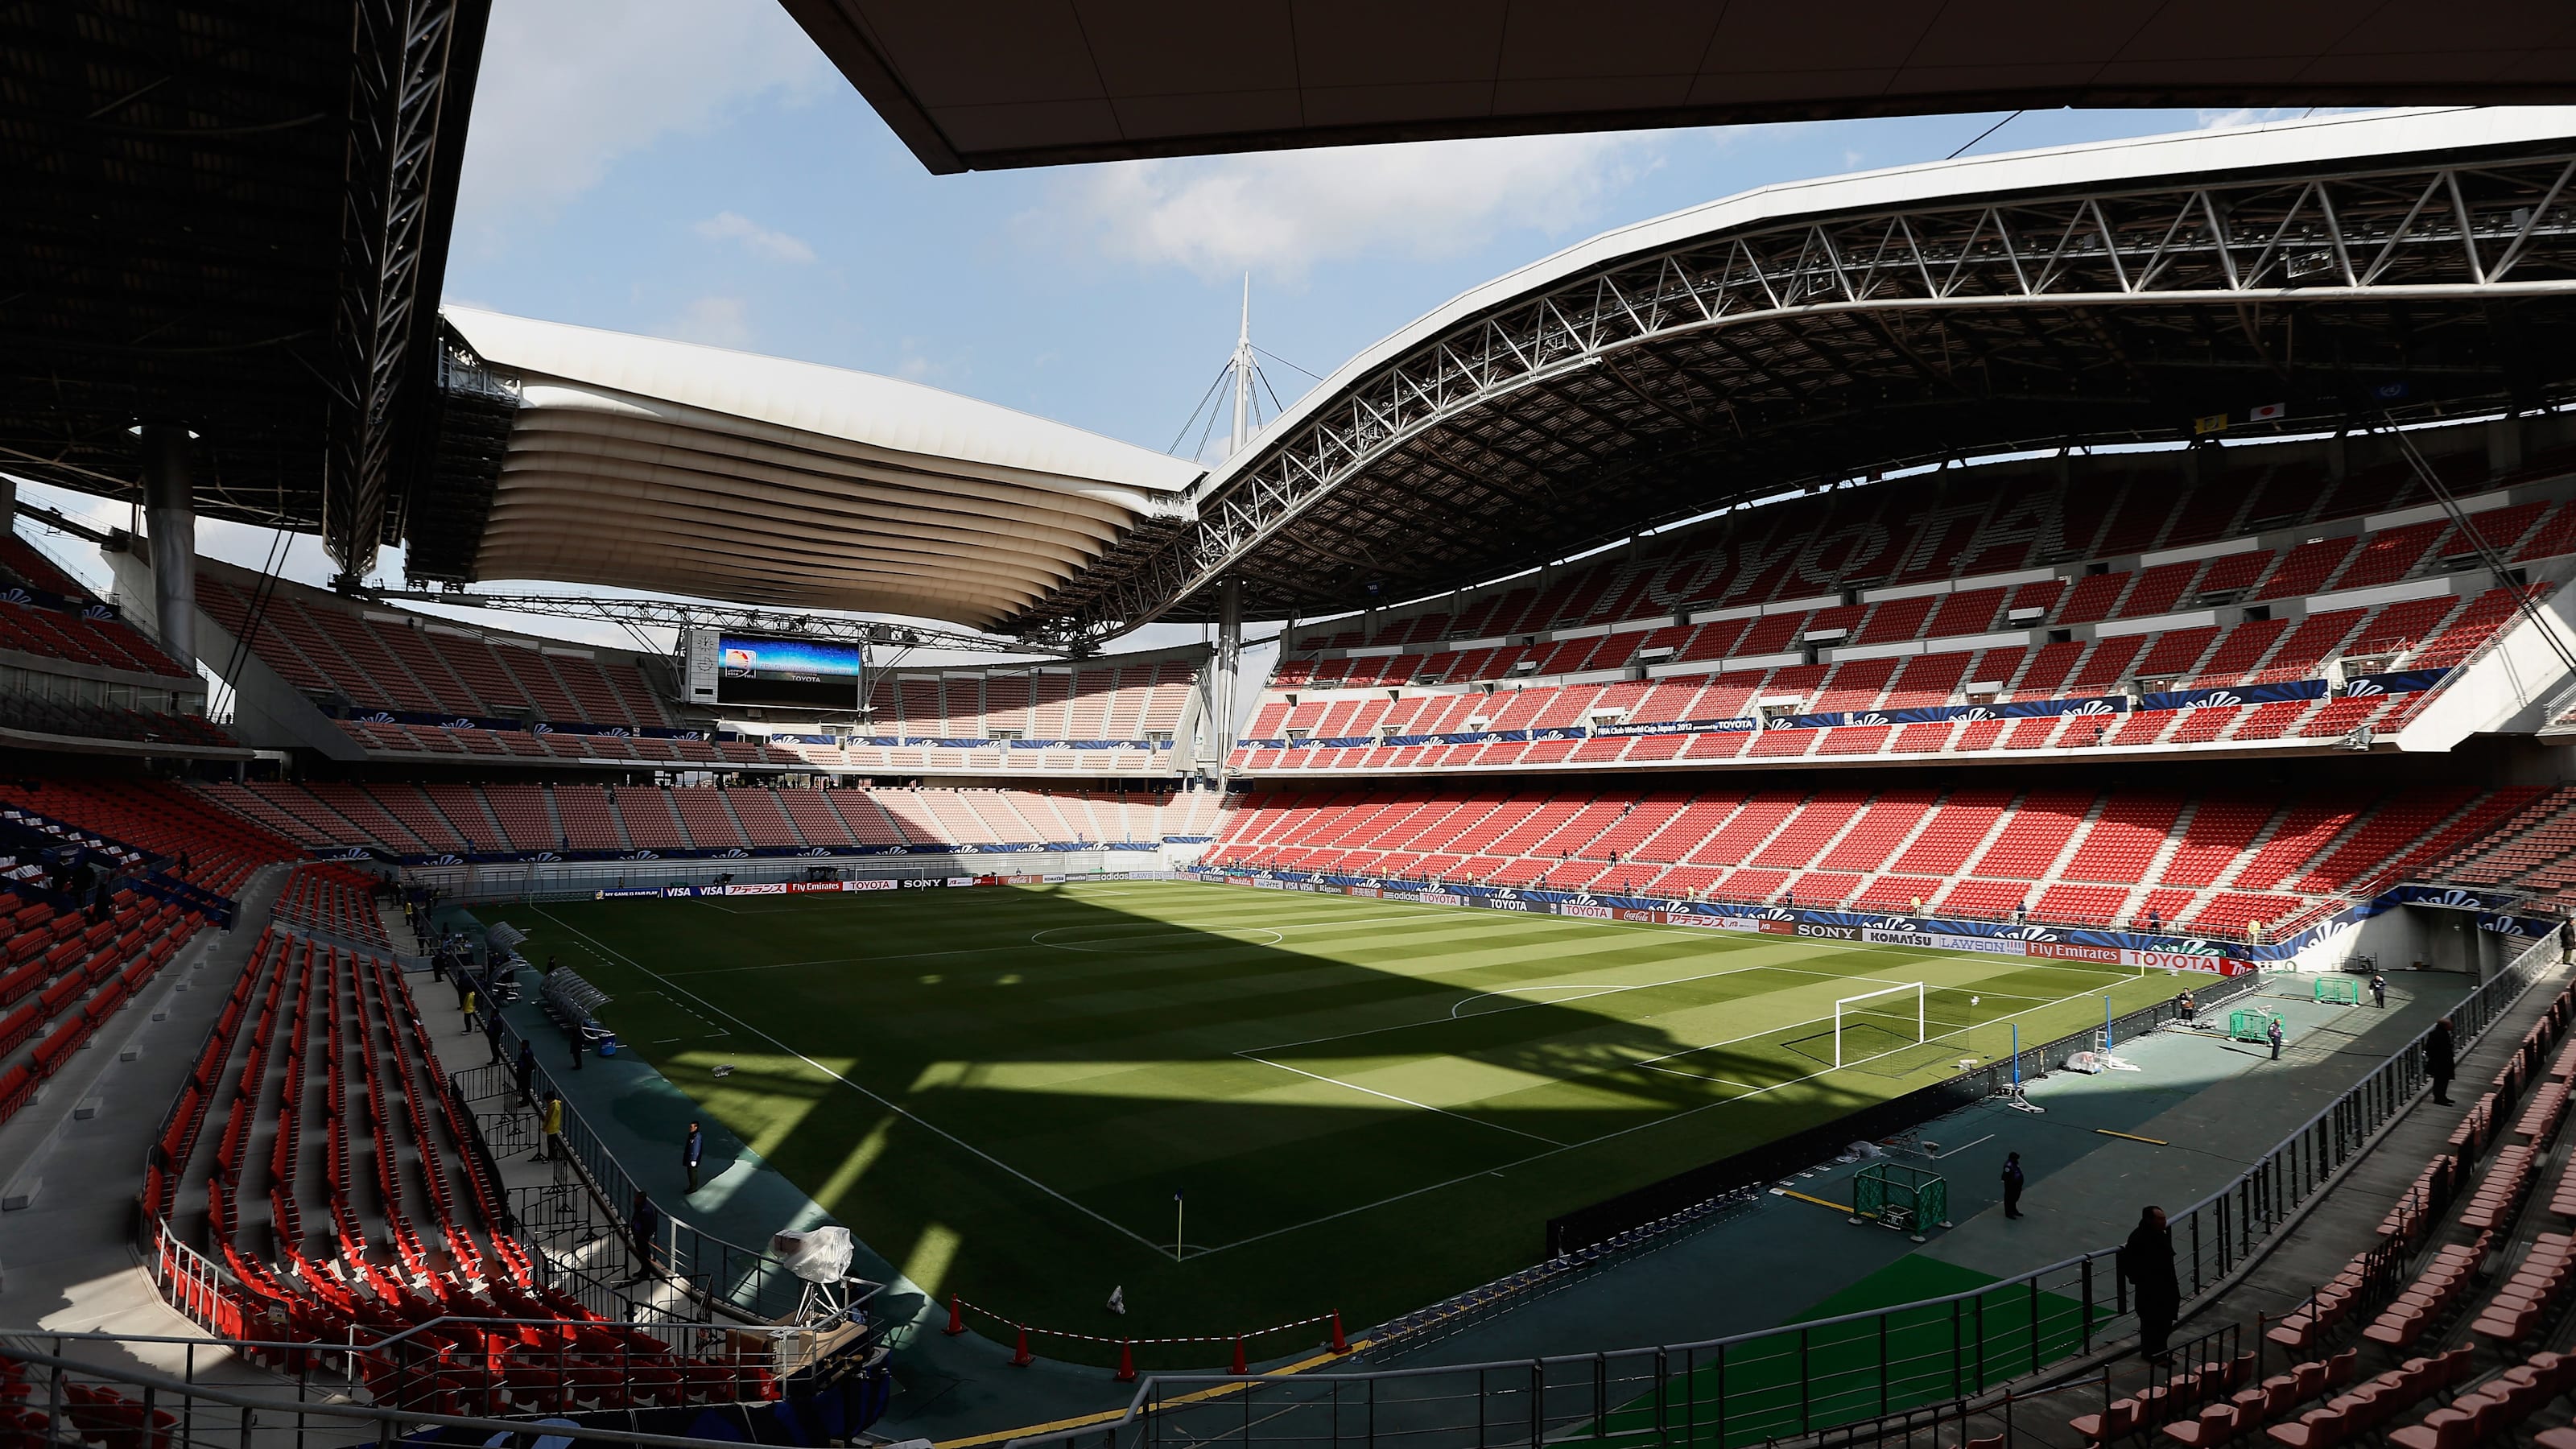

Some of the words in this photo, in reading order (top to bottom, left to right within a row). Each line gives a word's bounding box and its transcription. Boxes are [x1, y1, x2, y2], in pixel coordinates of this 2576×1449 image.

[1596, 492, 2067, 614] TOYOTA
[1644, 726, 1657, 734] Cup
[1657, 725, 1676, 733] Japan
[1719, 720, 1752, 729] TOYOTA
[1101, 872, 1128, 881] adidas
[1179, 872, 1198, 880] TOYOTA
[1203, 875, 1224, 883] FIFA.com
[793, 883, 805, 892] Fly
[807, 881, 839, 891] Emirates
[851, 881, 890, 890] TOYOTA
[904, 879, 942, 888] SONY
[1285, 881, 1298, 890] VISA
[1300, 883, 1313, 892] VISA
[667, 887, 691, 897] VISA
[699, 886, 723, 896] VISA
[729, 885, 783, 894] アデランス
[1394, 892, 1419, 902] adidas
[1424, 894, 1456, 904] TOYOTA
[1490, 898, 1527, 911] TOYOTA
[1566, 905, 1607, 918] TOYOTA
[1669, 914, 1725, 927] アデランス
[1798, 924, 1856, 939] SONY
[1870, 932, 1932, 946] KOMATSU
[1942, 938, 2005, 952] LAWSON
[2030, 942, 2053, 957] Fly
[2055, 943, 2117, 960] Emirates
[2130, 952, 2216, 971] TOYOTA
